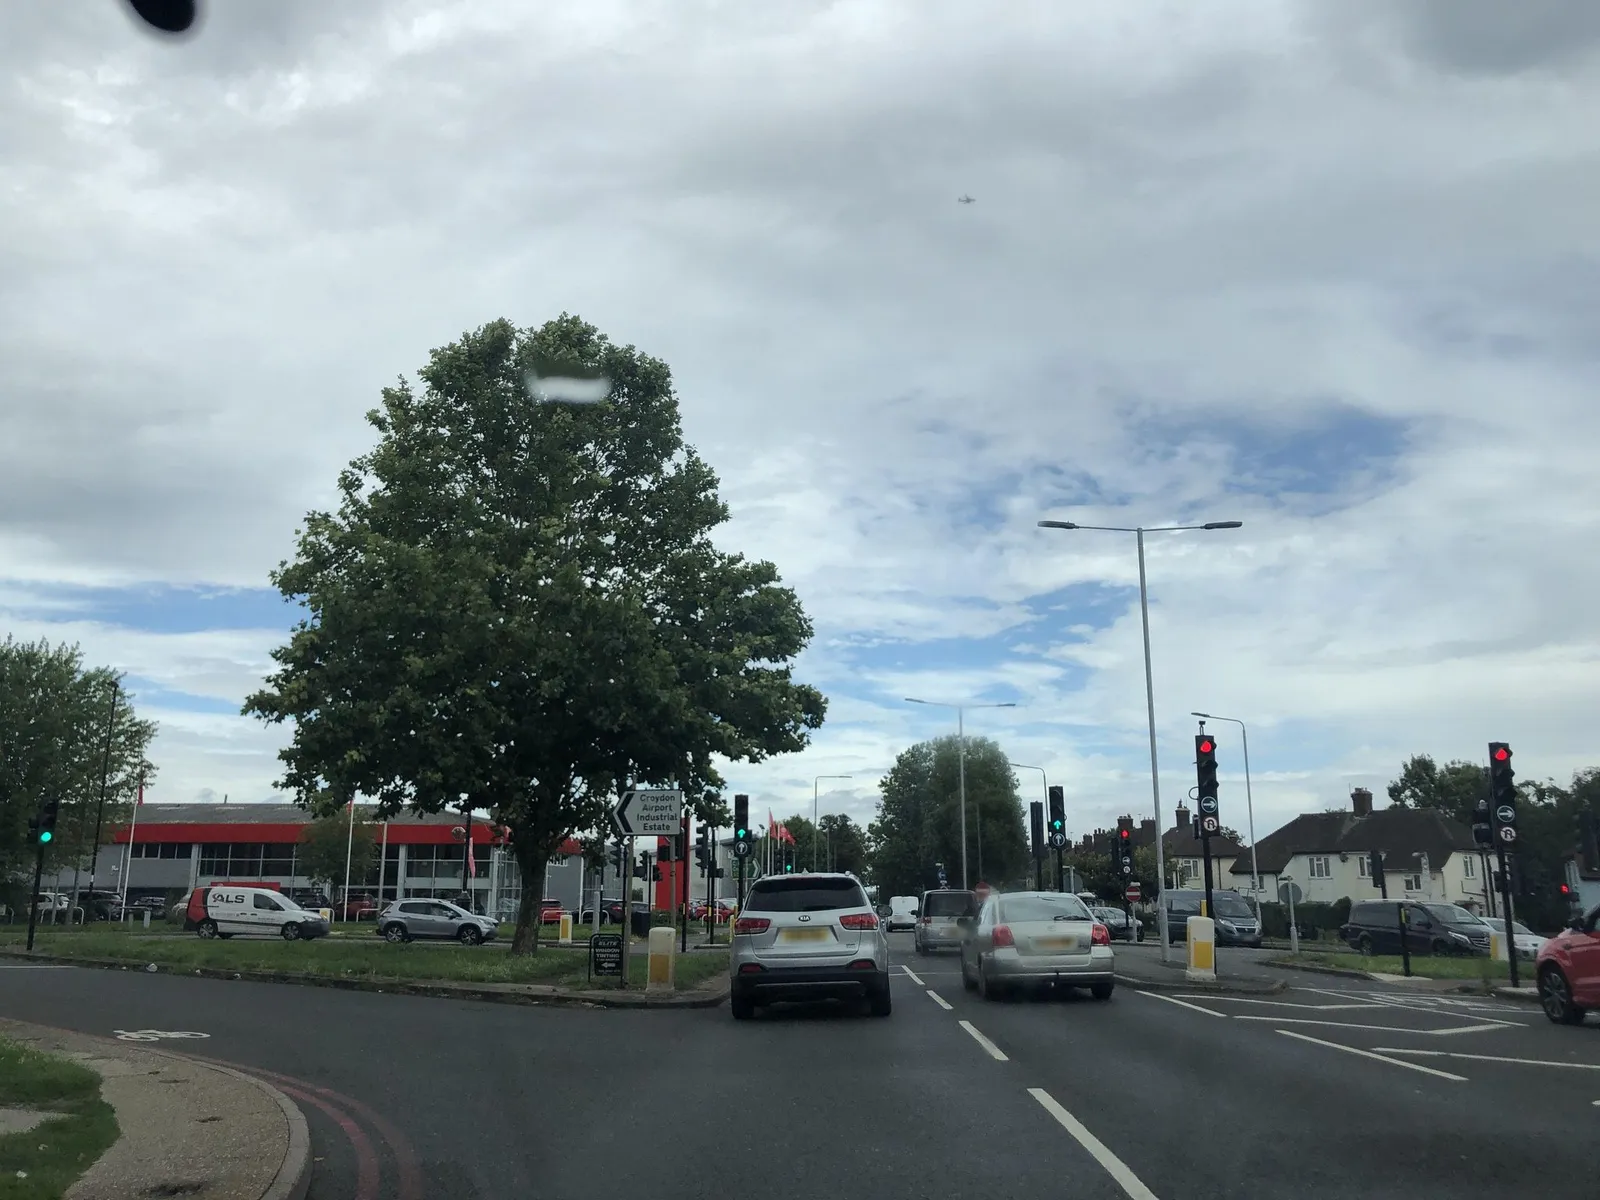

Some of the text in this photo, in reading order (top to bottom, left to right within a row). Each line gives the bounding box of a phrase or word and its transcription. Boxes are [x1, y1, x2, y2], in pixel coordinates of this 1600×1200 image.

[640, 794, 676, 802] Croydon
[642, 804, 672, 812] Airport
[637, 813, 678, 821] Industrial
[212, 893, 245, 904] ALS
